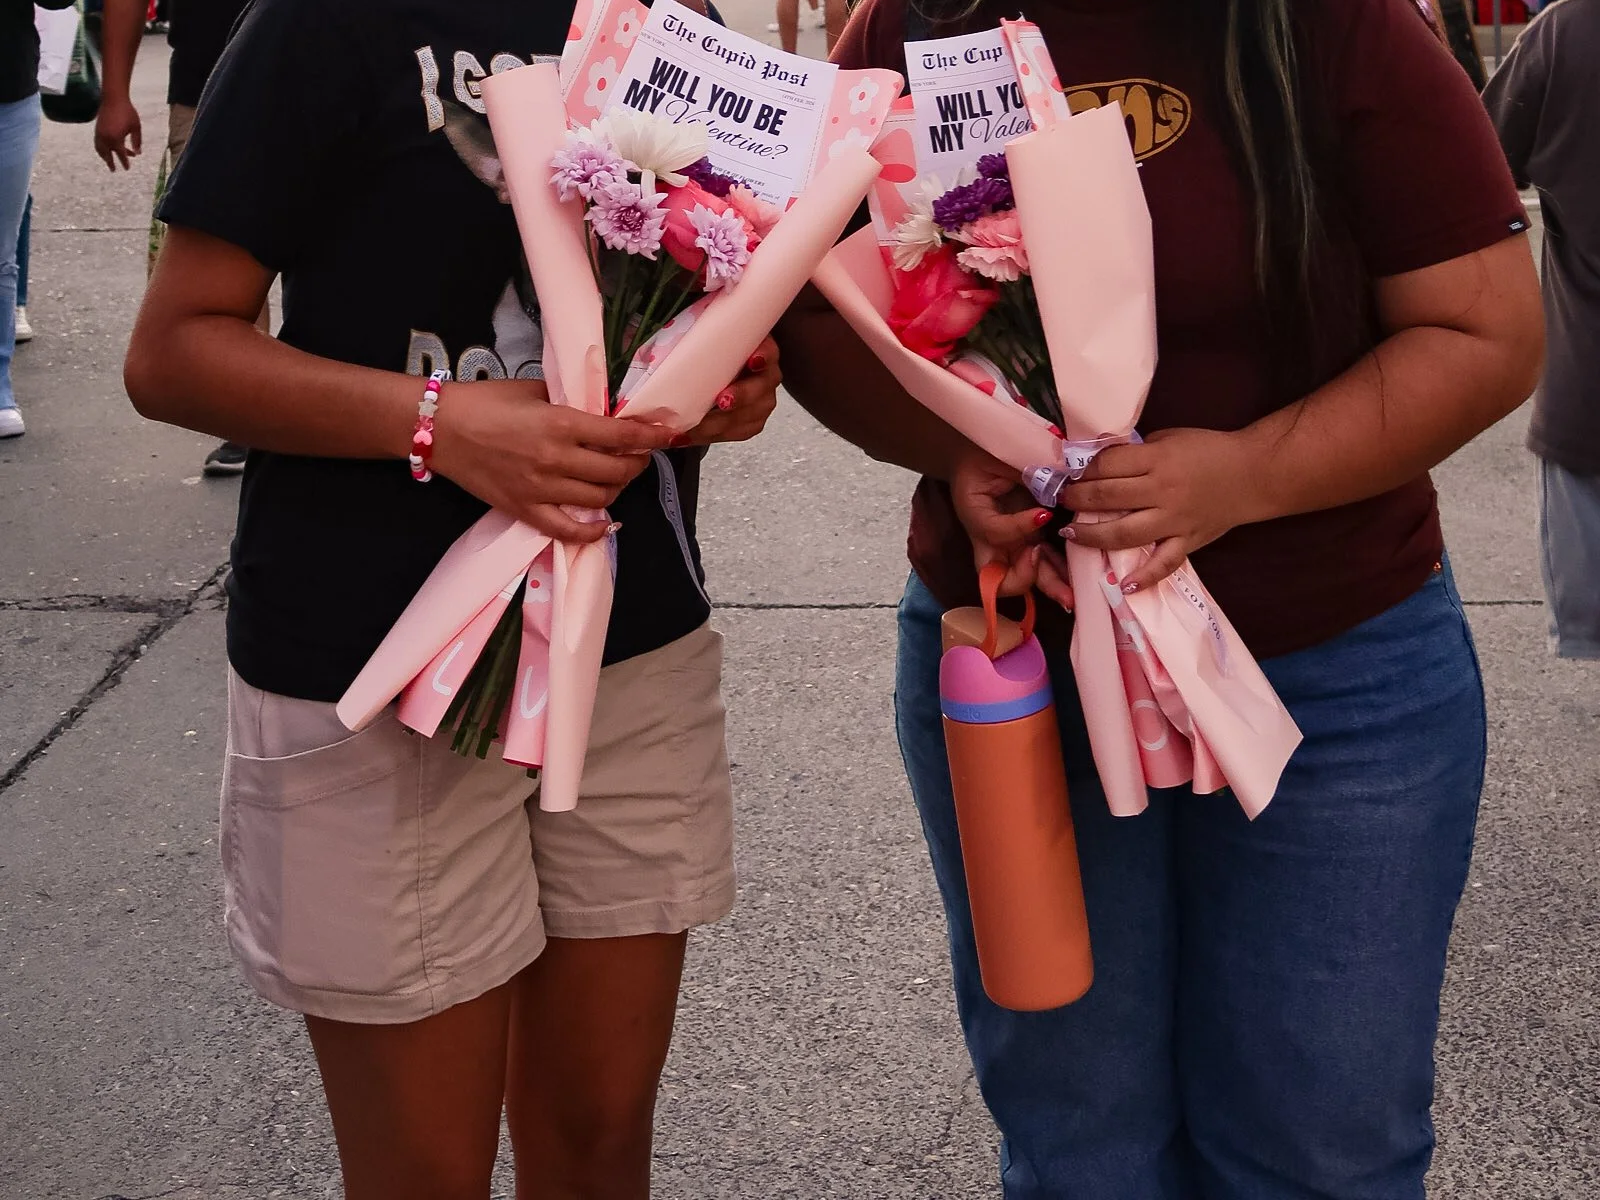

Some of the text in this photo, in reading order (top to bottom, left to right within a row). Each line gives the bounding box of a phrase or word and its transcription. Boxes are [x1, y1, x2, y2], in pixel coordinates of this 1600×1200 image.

[663, 14, 808, 87] The Cupid Post
[922, 46, 1003, 71] The Cup
[622, 78, 666, 115] MY
[648, 56, 788, 136] WILL YOU BE
[936, 81, 1025, 123] WILL YO
[929, 122, 964, 153] MY
